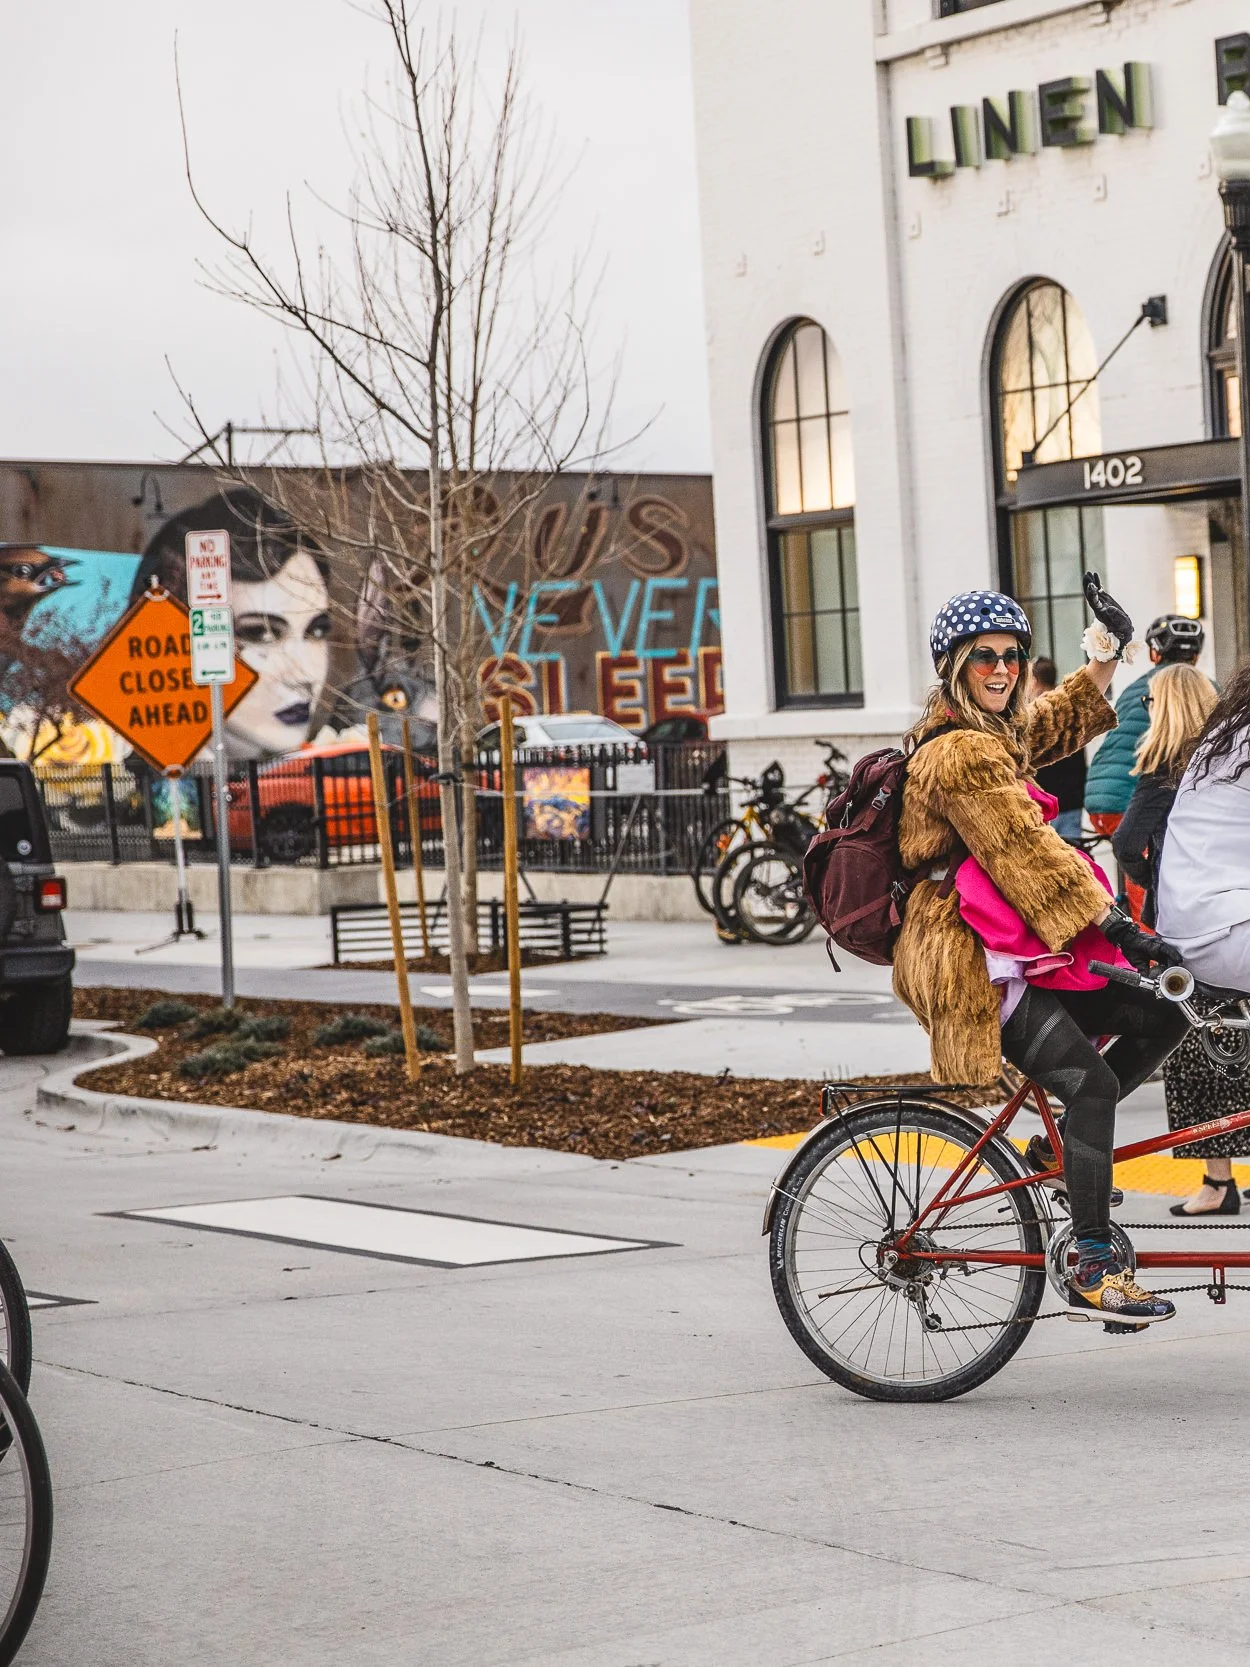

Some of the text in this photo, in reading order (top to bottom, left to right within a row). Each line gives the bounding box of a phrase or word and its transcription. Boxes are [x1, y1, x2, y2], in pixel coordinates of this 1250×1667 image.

[906, 60, 1154, 178] LINEN
[1083, 455, 1143, 490] 1402
[200, 539, 215, 553] NO
[190, 554, 227, 570] PARKING
[193, 611, 203, 636] 2
[119, 666, 209, 696] CLOSE
[130, 700, 208, 728] AHEAD
[776, 1218, 787, 1259] MICHELIN
